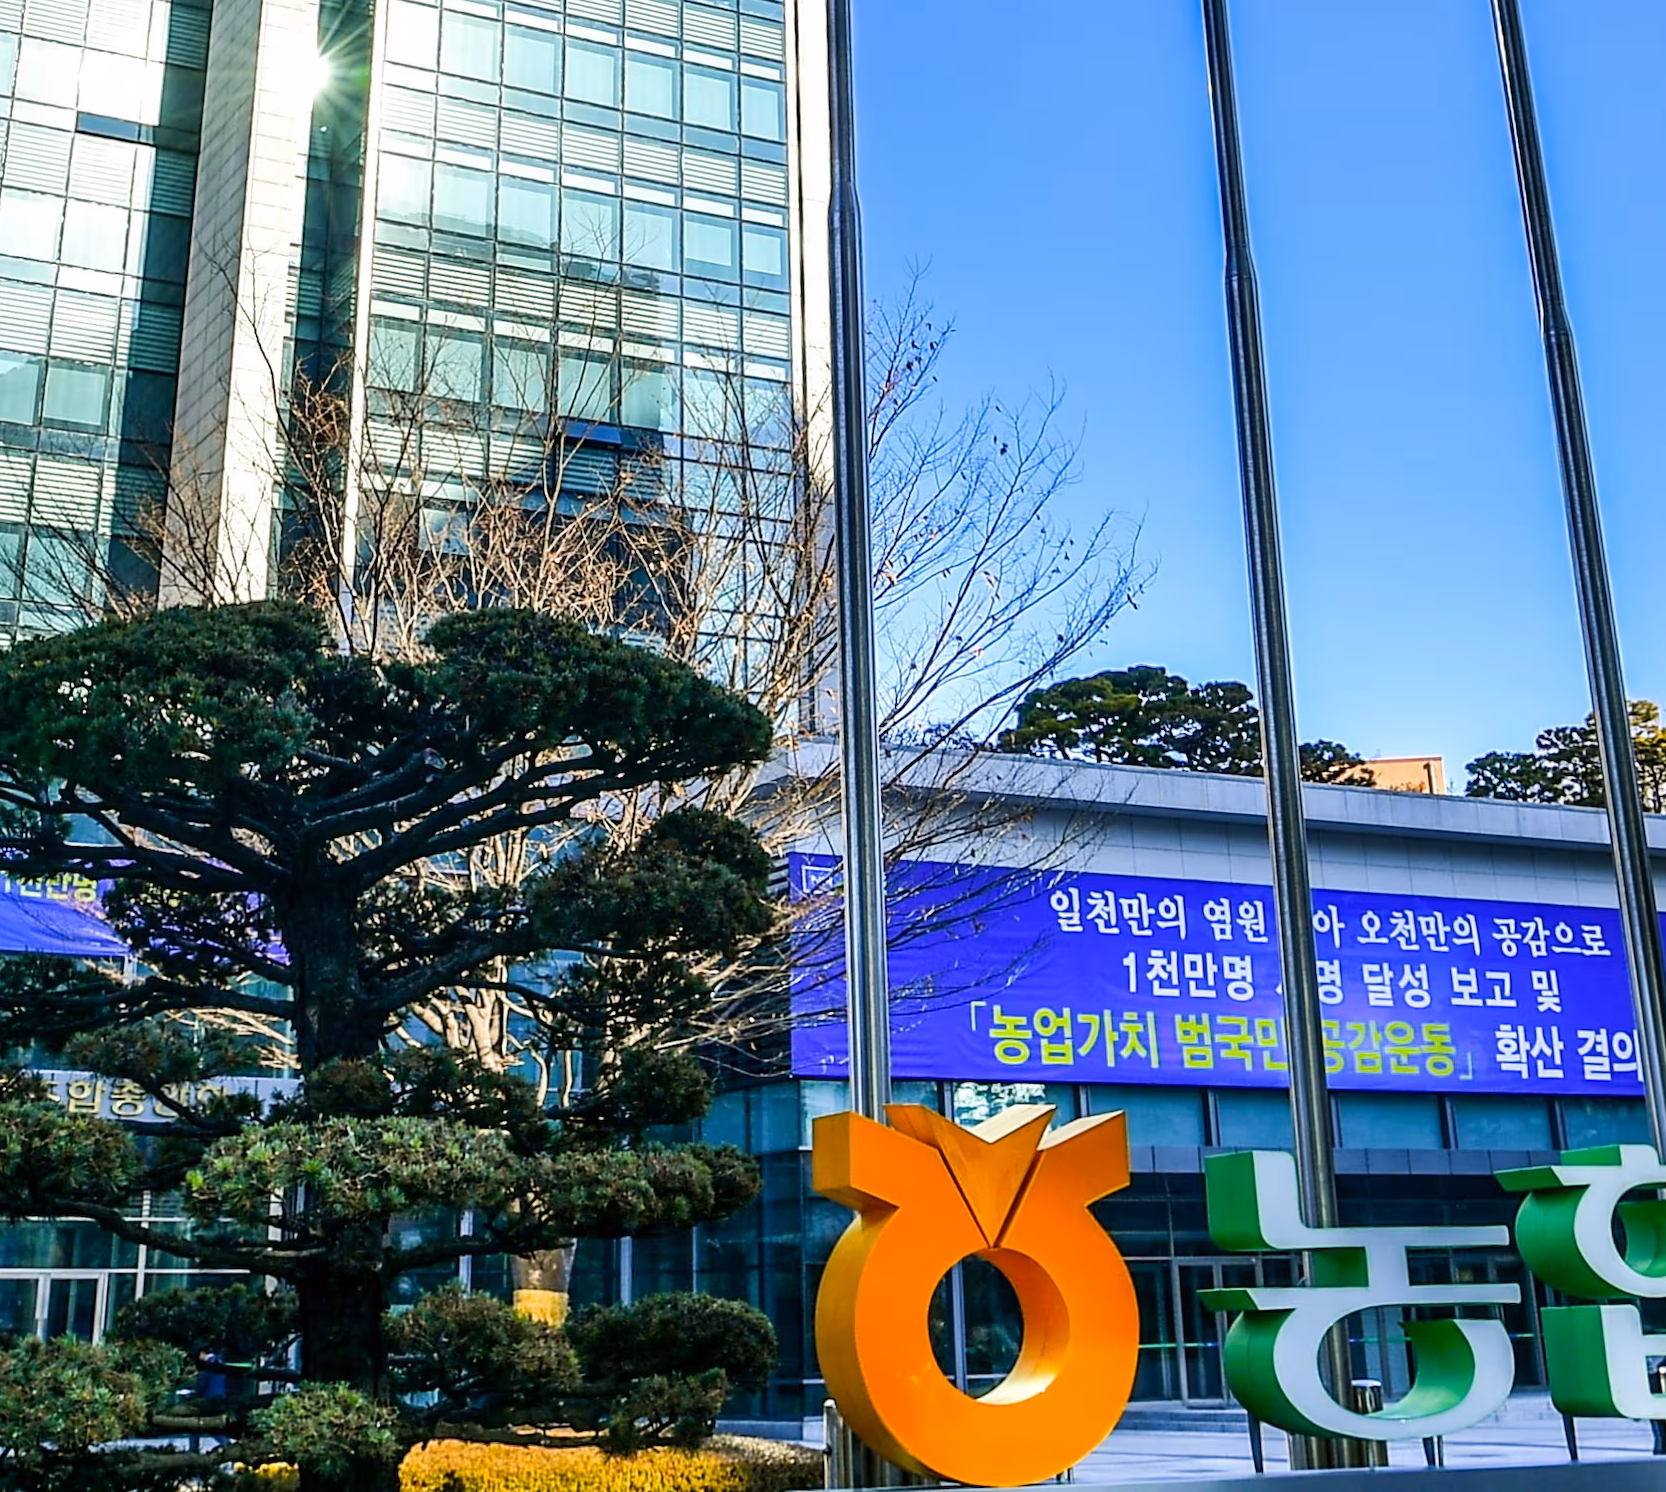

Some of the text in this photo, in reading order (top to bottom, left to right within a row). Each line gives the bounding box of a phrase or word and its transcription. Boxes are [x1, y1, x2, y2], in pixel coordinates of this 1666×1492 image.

[1049, 886, 1186, 940] 일천만의
[1203, 897, 1269, 944] 염원
[1356, 909, 1481, 957] 오천만의
[1491, 917, 1612, 958] 공감으로
[1122, 949, 1255, 1002] 1천만명
[1361, 962, 1432, 1009] 달성
[1450, 966, 1518, 1008] 보고
[1530, 969, 1562, 1013] 및
[1494, 1024, 1565, 1080] 확산
